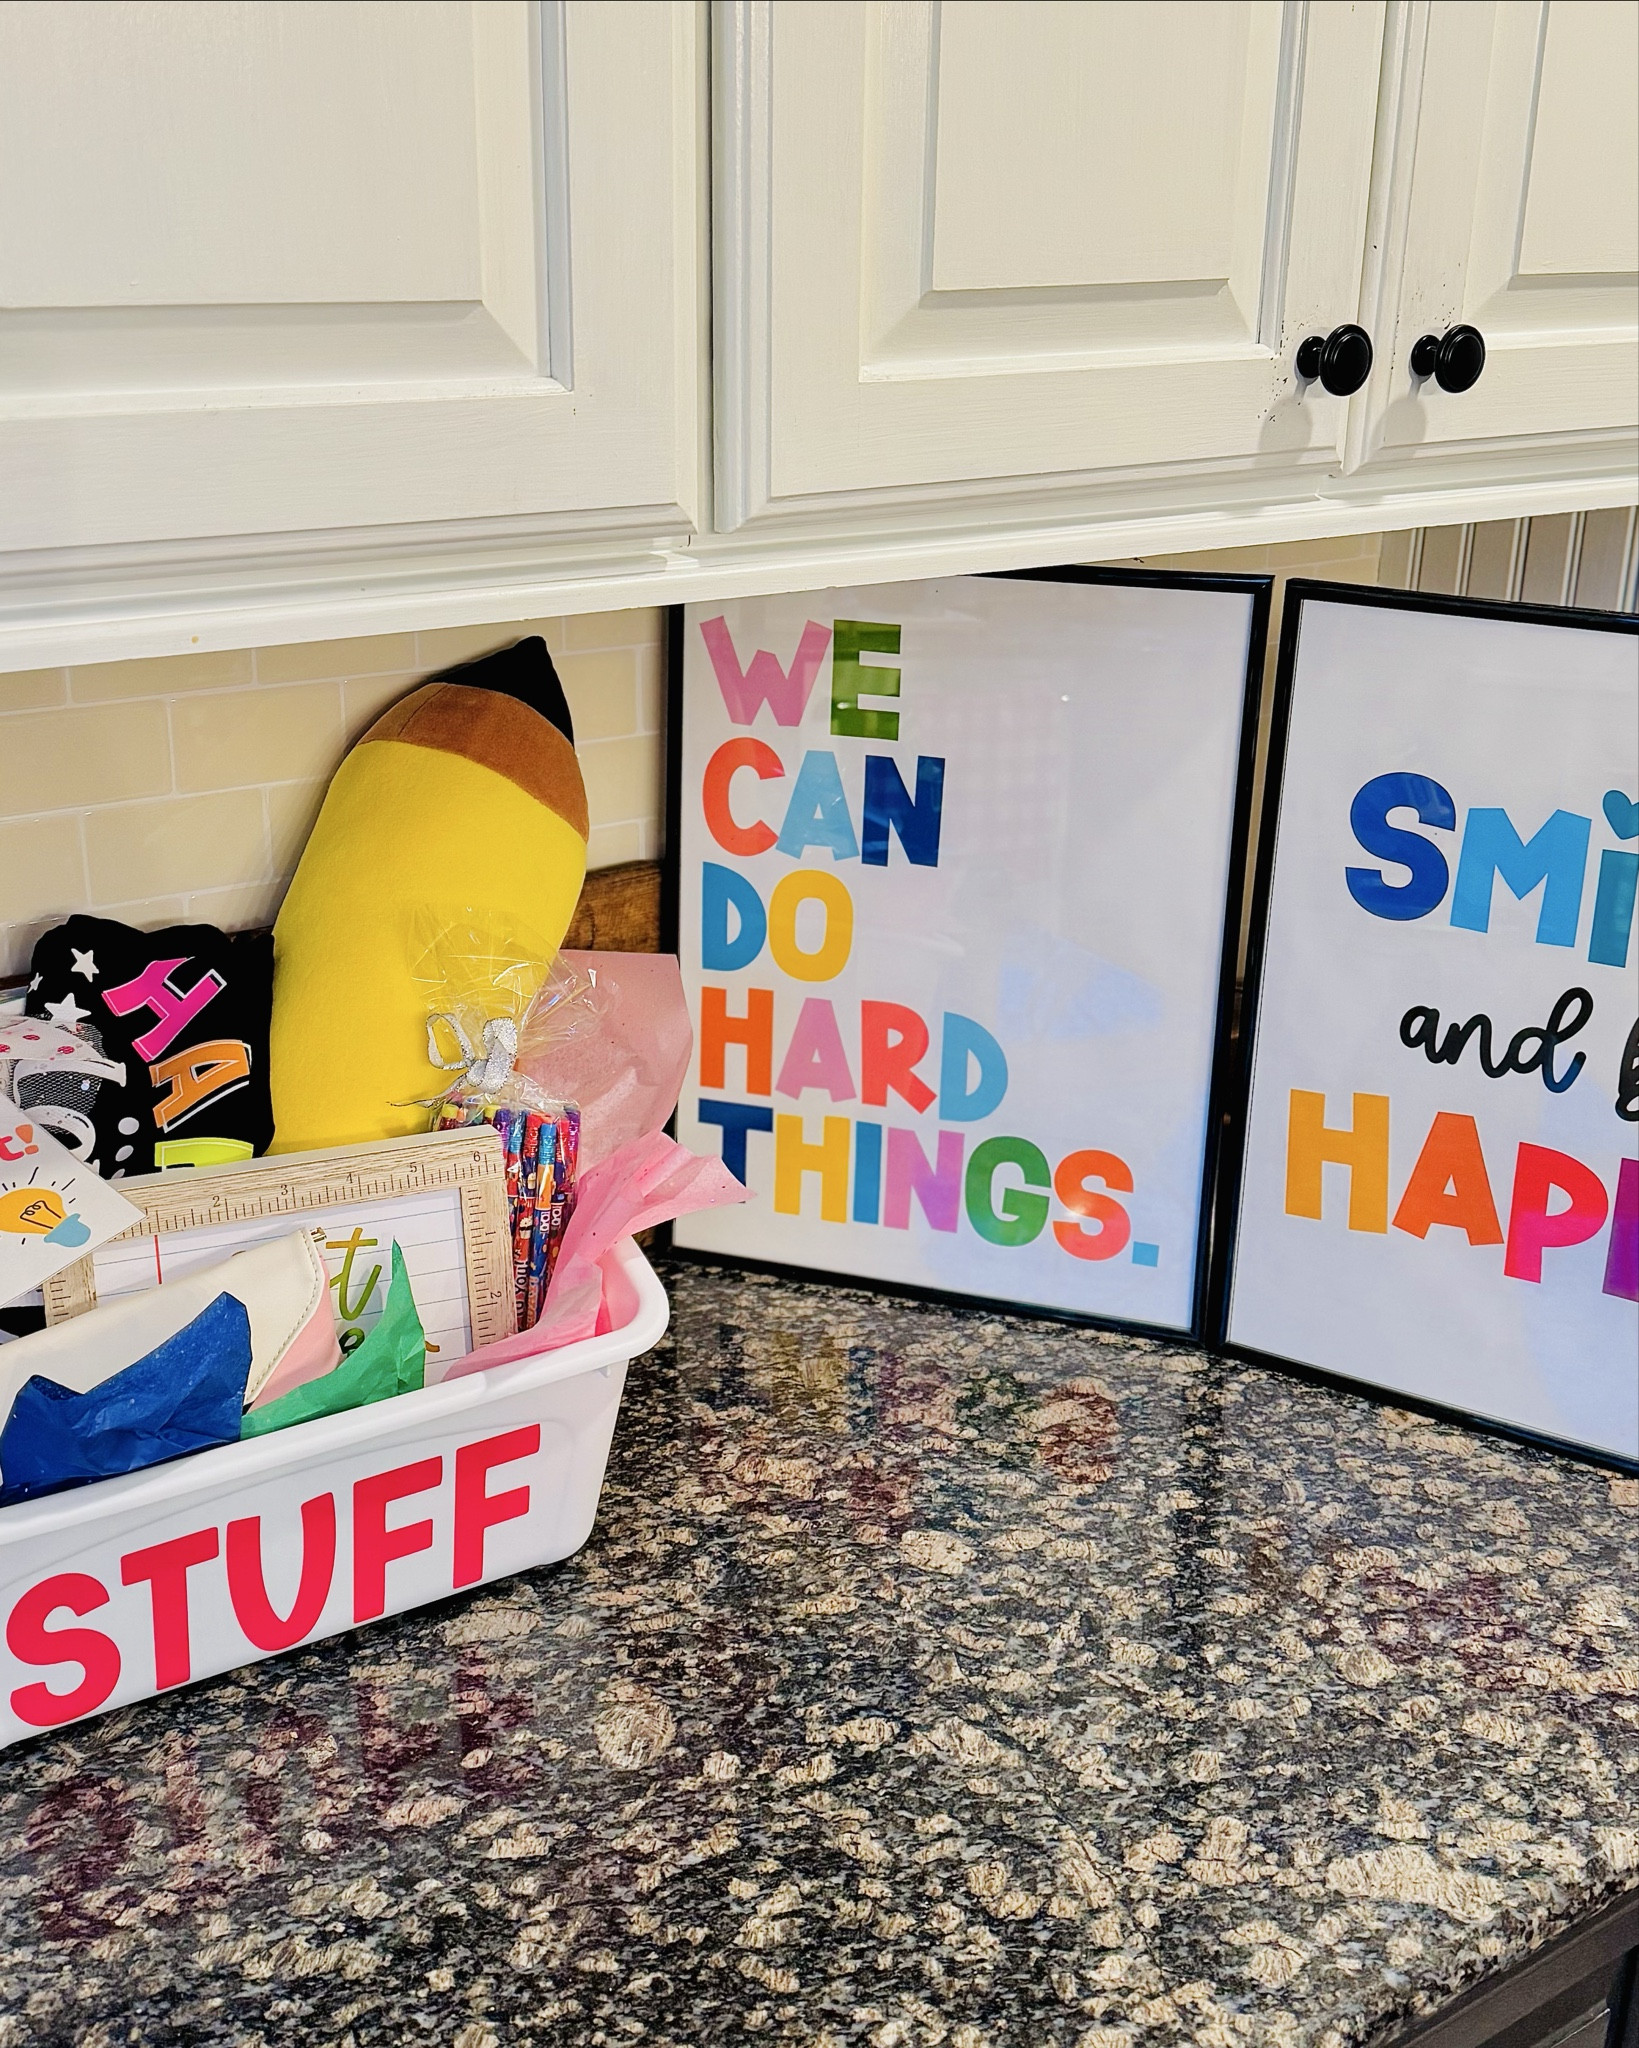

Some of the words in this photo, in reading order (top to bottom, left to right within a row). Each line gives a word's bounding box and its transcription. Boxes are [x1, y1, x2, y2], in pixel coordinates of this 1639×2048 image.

[700, 615, 901, 741] WE
[702, 737, 946, 868] CAN
[702, 861, 854, 982] DO
[700, 987, 1008, 1122] HARD
[1400, 987, 1594, 1093] and
[212, 1196, 221, 1208] 2
[280, 1185, 289, 1196] 3
[409, 1162, 418, 1173] 5
[473, 1151, 482, 1163] 6
[698, 1098, 1159, 1267] THINGS.
[490, 1290, 502, 1299] 2
[6, 1424, 541, 1726] STUFF
